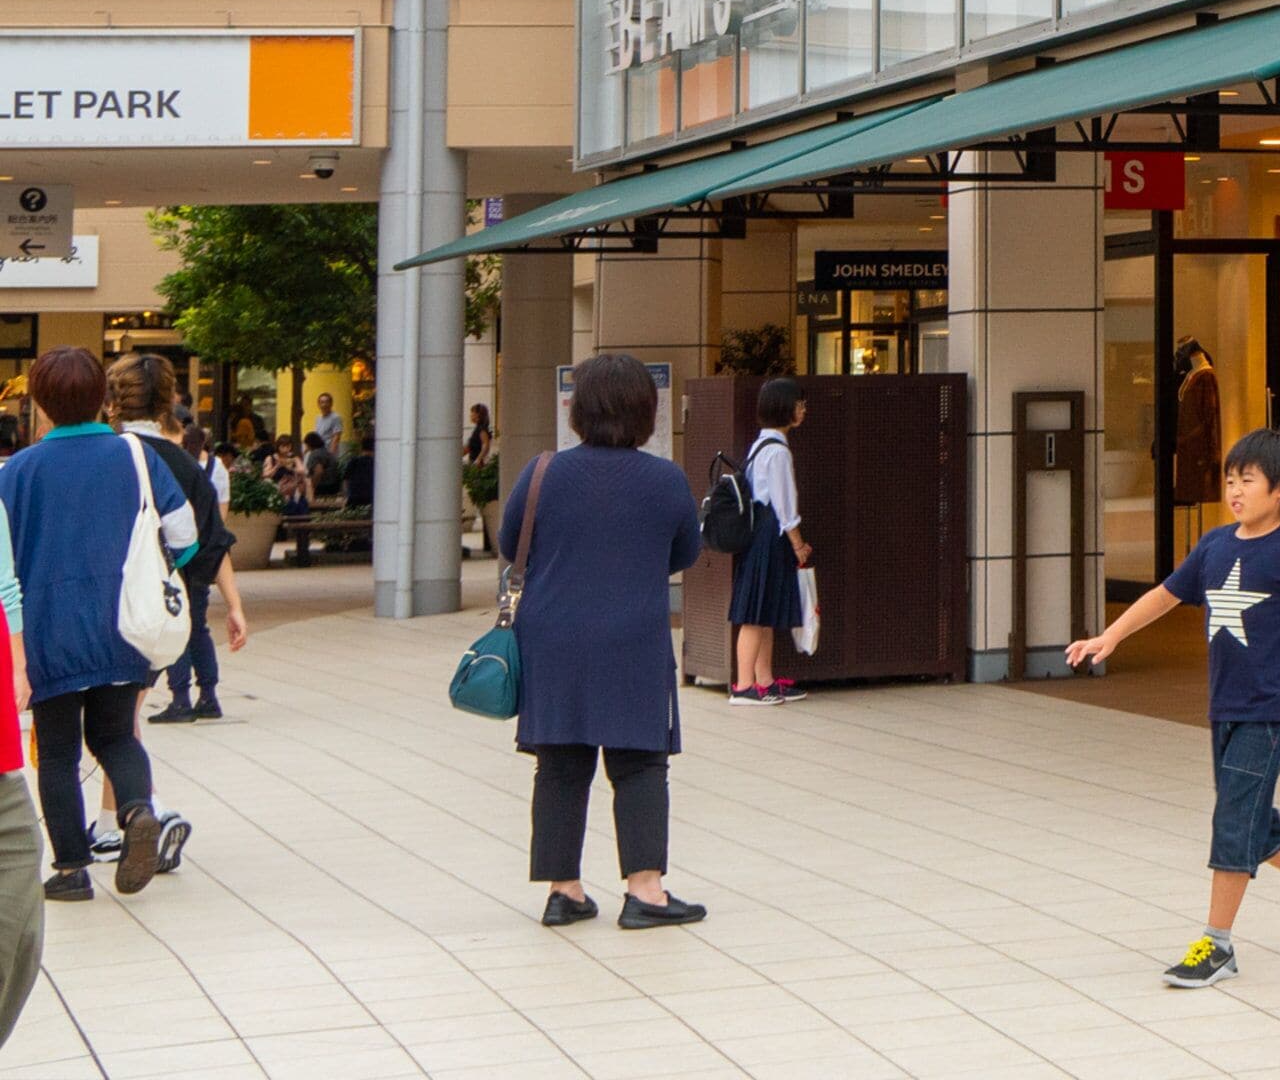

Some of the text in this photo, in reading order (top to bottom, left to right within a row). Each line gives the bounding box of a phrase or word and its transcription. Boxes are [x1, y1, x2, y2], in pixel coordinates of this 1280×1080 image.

[74, 90, 181, 119] PARK
[833, 264, 948, 277] JOHN SMEDLEY
